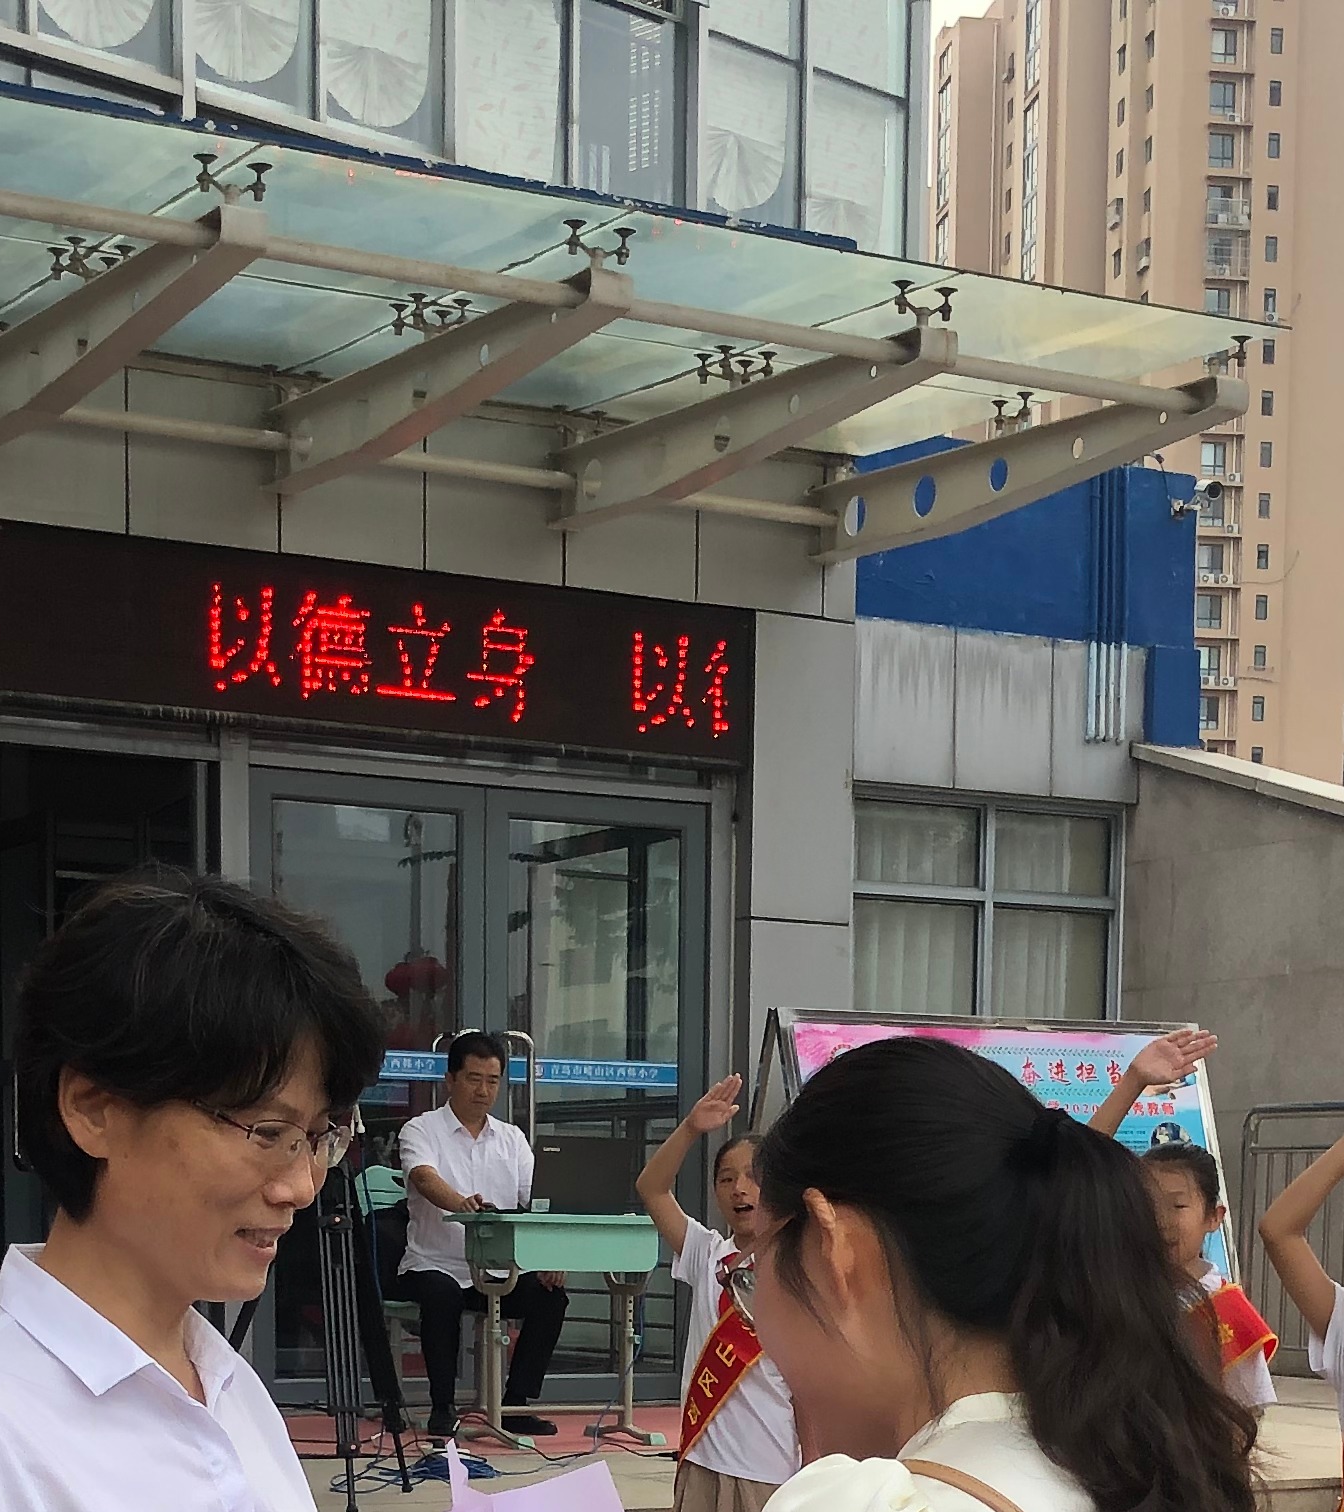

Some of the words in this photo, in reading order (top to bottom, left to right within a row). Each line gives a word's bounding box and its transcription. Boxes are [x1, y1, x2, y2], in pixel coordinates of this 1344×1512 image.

[207, 581, 535, 723] 以德立身
[384, 1057, 436, 1070] 西韩小学
[1020, 1056, 1124, 1086] 奋进担当
